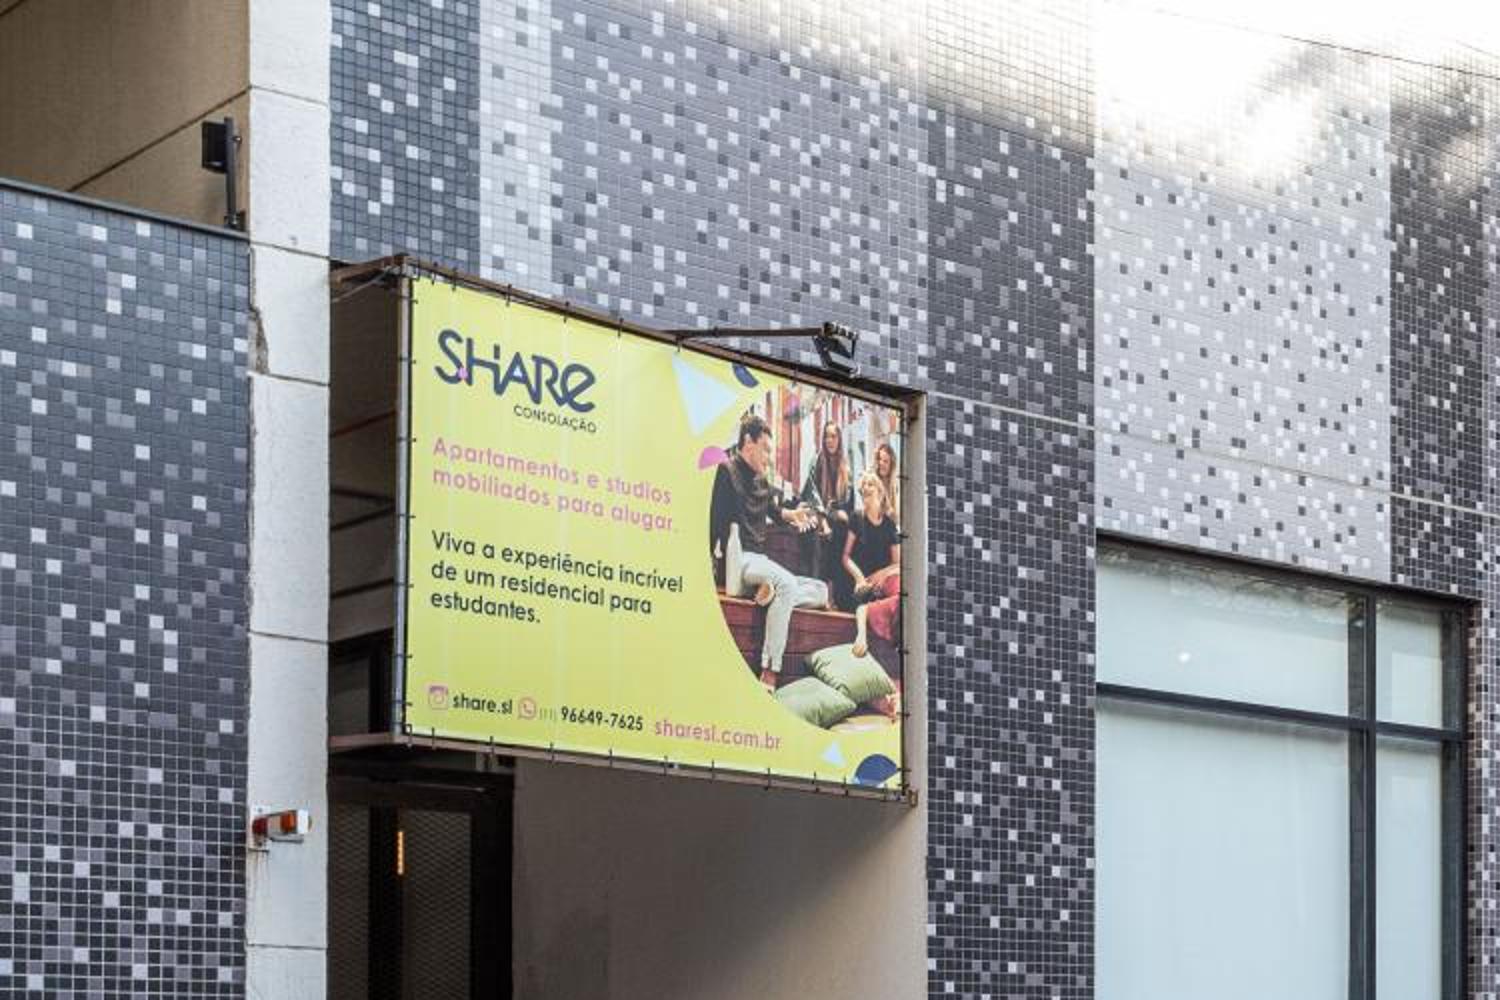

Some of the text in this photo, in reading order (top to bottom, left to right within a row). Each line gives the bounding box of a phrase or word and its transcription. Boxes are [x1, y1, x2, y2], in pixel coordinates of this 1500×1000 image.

[513, 405, 597, 434] CONSOLAÇÃO
[433, 437, 672, 505] Apartamentos e studios
[433, 469, 551, 507] mobiliados
[557, 494, 605, 517] para
[432, 530, 475, 556] Viva
[483, 542, 495, 559] a
[501, 547, 614, 581] experiência
[430, 592, 541, 624] estudantes.
[431, 560, 652, 614] de um residencial para
[453, 692, 513, 714] share.sl
[561, 706, 643, 731] 96649-7625
[655, 720, 782, 749] sharesl.com.br
